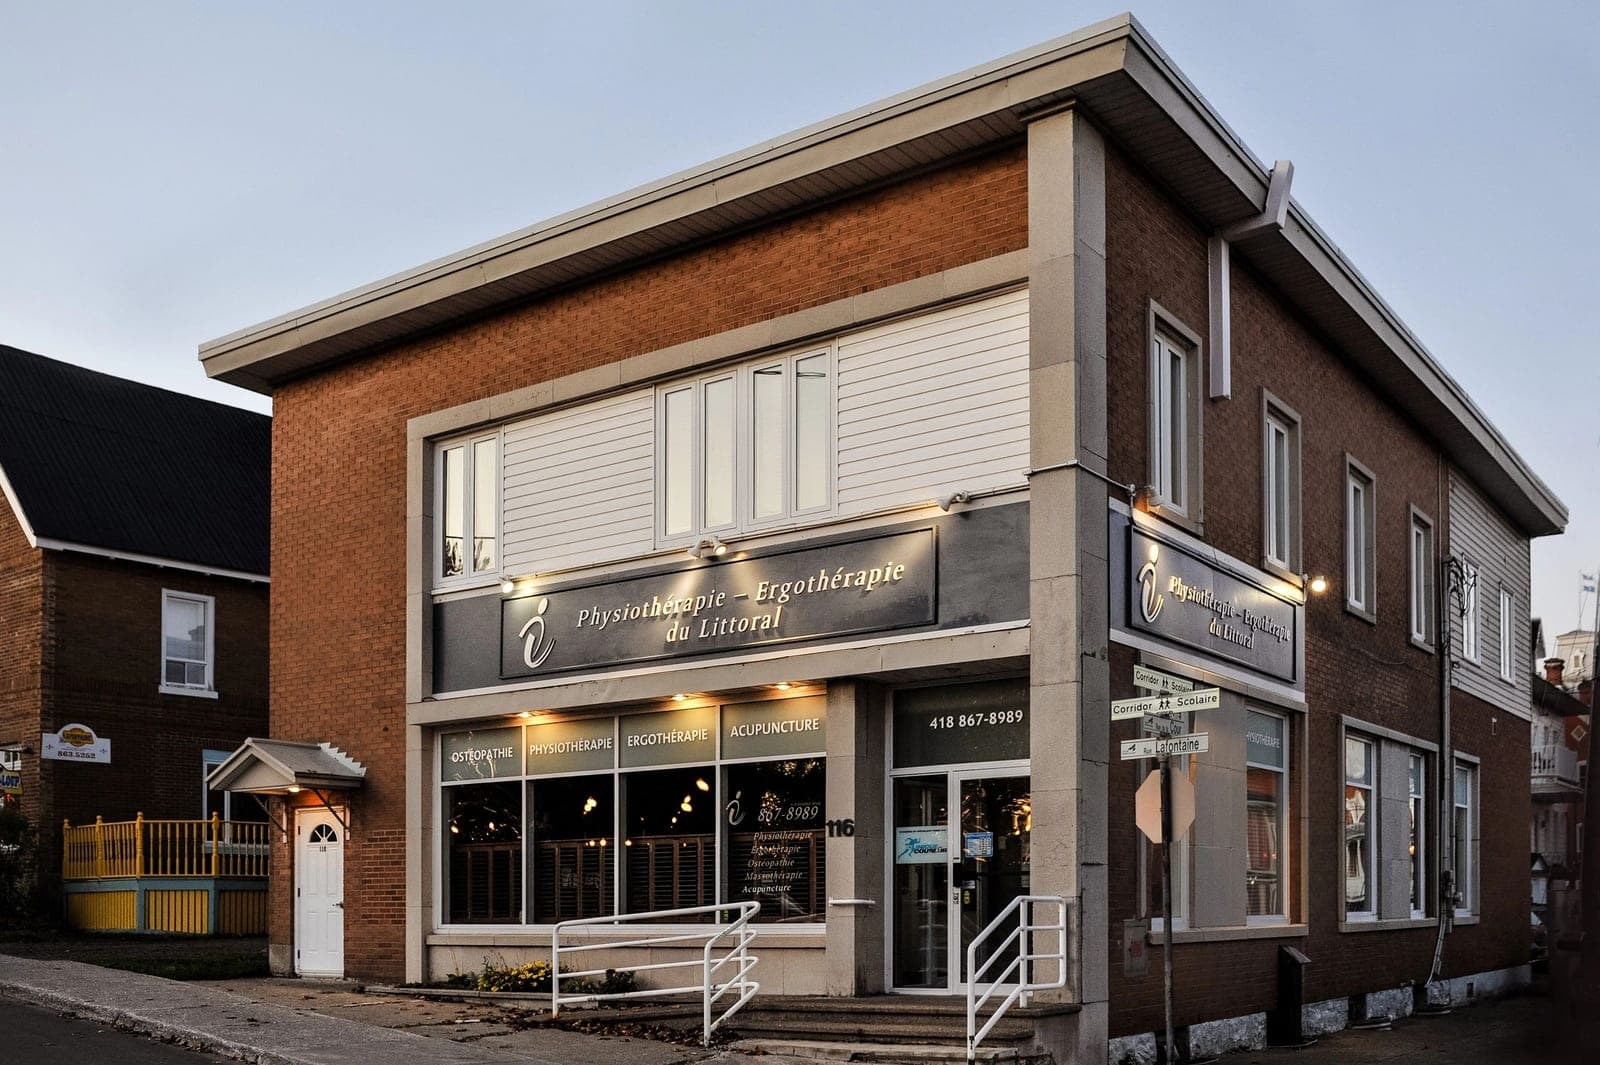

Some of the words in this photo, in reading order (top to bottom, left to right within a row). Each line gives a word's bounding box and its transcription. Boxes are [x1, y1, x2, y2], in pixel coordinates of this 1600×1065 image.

[576, 589, 726, 631] Physiothérapie
[756, 561, 905, 603] Ergothérapie
[1168, 575, 1235, 619] Physiothérapie
[1243, 608, 1291, 643] Ergothérapie
[666, 620, 691, 643] du
[698, 605, 784, 639] Littoral
[1209, 617, 1221, 637] du
[1223, 623, 1255, 650] Littoral
[1135, 670, 1160, 685] Corridor
[1113, 702, 1153, 714] Corridor
[1177, 694, 1217, 707] Scolaire
[730, 718, 820, 738] ACUPUNCTURE
[929, 715, 954, 729] 418
[958, 709, 1024, 728] 867-8989
[529, 737, 613, 756] PHYSIOTHÉRAPIE
[627, 728, 708, 747] ERGOTHÉRAPIE
[1155, 738, 1200, 753] Lafontaine
[451, 747, 513, 763] OSTÉOPATHIE
[758, 805, 819, 822] 867-8989
[753, 831, 814, 842] Physiothérapie
[825, 818, 855, 838] 116
[742, 883, 792, 895] Acupuncture
